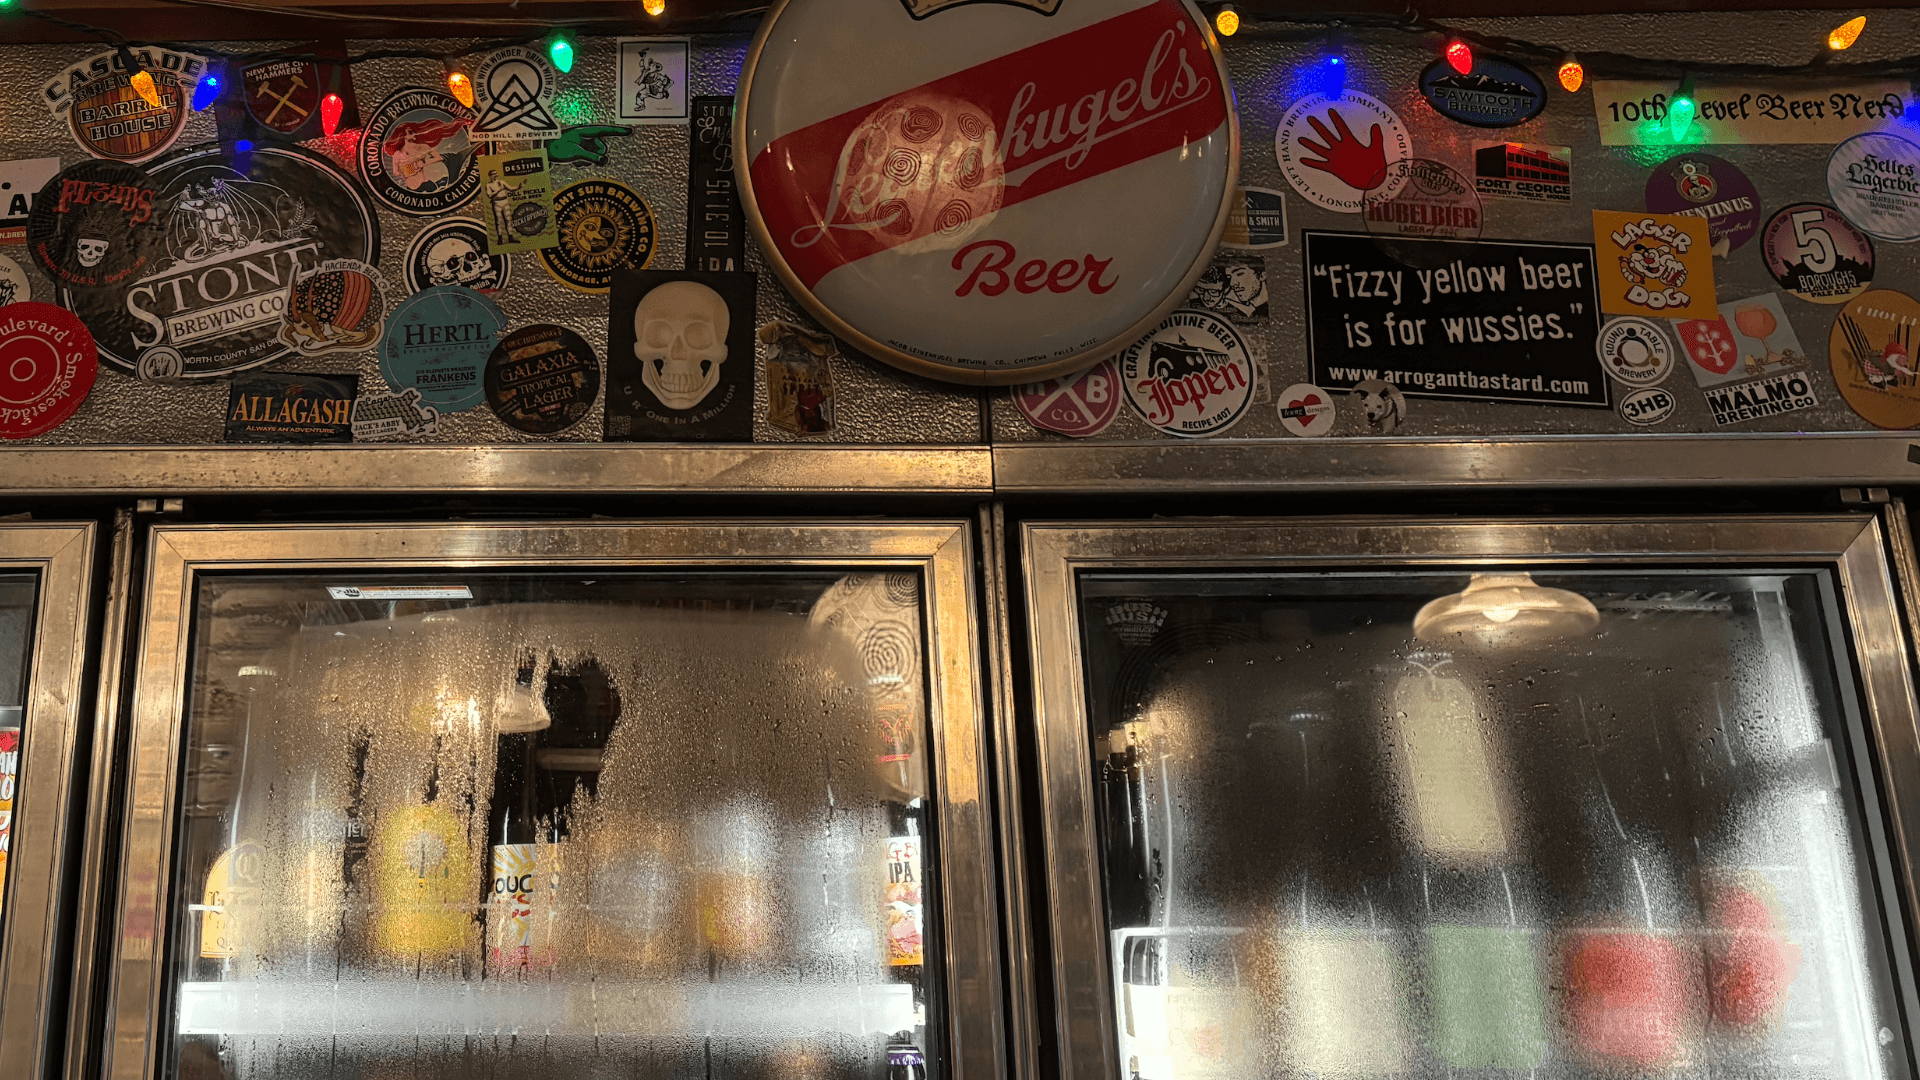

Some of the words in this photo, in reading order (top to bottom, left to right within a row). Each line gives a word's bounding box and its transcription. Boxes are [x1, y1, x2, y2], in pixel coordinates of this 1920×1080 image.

[245, 67, 265, 78] NEW
[266, 62, 290, 72] YORK
[256, 66, 303, 81] HAMMERS
[1344, 95, 1394, 124] OMPANY
[1434, 87, 1532, 109] SAWTOOTH
[1447, 101, 1517, 116] BREWERY
[1693, 93, 1751, 120] evel
[1755, 93, 1825, 120] Beer
[1286, 96, 1324, 127] BREWIN
[89, 113, 172, 141] HOUSE
[366, 115, 389, 177] CORONADO
[386, 94, 438, 118] BREWING
[1281, 129, 1291, 162] HAND
[1287, 166, 1310, 192] LEFT
[1476, 178, 1512, 189] FORT
[1516, 183, 1570, 194] GEORGE
[1845, 162, 1920, 194] Lagerbie
[577, 186, 604, 196] SUN
[607, 187, 649, 234] BREWING
[704, 179, 731, 248] 10.31.15
[1248, 216, 1255, 226] &
[1256, 216, 1280, 226] SMITH
[1610, 218, 1692, 254] LAGER
[1790, 209, 1837, 274] 5
[325, 261, 362, 272] HACIENDA
[364, 267, 380, 281] BEER
[951, 239, 1119, 297] Beer
[1417, 260, 1506, 305] yellow
[1518, 256, 1583, 291] beer
[126, 242, 319, 350] STONE
[1623, 284, 1691, 310] DOG
[0, 317, 70, 343] ulevard
[173, 303, 256, 338] BREWING
[1160, 315, 1206, 330] DIVINE
[1207, 323, 1236, 350] BEER
[1343, 313, 1373, 349] is
[1383, 312, 1426, 346] for
[403, 322, 490, 346] HERTL
[1606, 327, 1625, 356] ROUND
[1639, 327, 1664, 354] TABLE
[185, 355, 212, 365] NORTH
[214, 349, 248, 363] COUNTY
[249, 342, 265, 354] SAN
[501, 351, 579, 382] GALAXIA
[416, 371, 476, 384] FRANKENS
[518, 374, 571, 395] TROPICAL
[1619, 367, 1657, 378] BREWERY
[523, 385, 573, 410] LAGER
[623, 385, 633, 396] U
[232, 392, 351, 426] ALLAGASH
[632, 400, 641, 410] R
[646, 410, 670, 424] ONE
[674, 416, 687, 425] IN
[691, 415, 700, 424] A
[702, 384, 736, 420] MILLION
[1051, 409, 1082, 423] CO.
[1625, 393, 1670, 417] 3HB
[1715, 400, 1794, 425] BREWING
[1794, 397, 1814, 408] CO
[380, 420, 400, 429] ABBY
[1182, 418, 1212, 429] RECIPE
[1212, 407, 1231, 423] 1407
[888, 862, 915, 884] IPA
